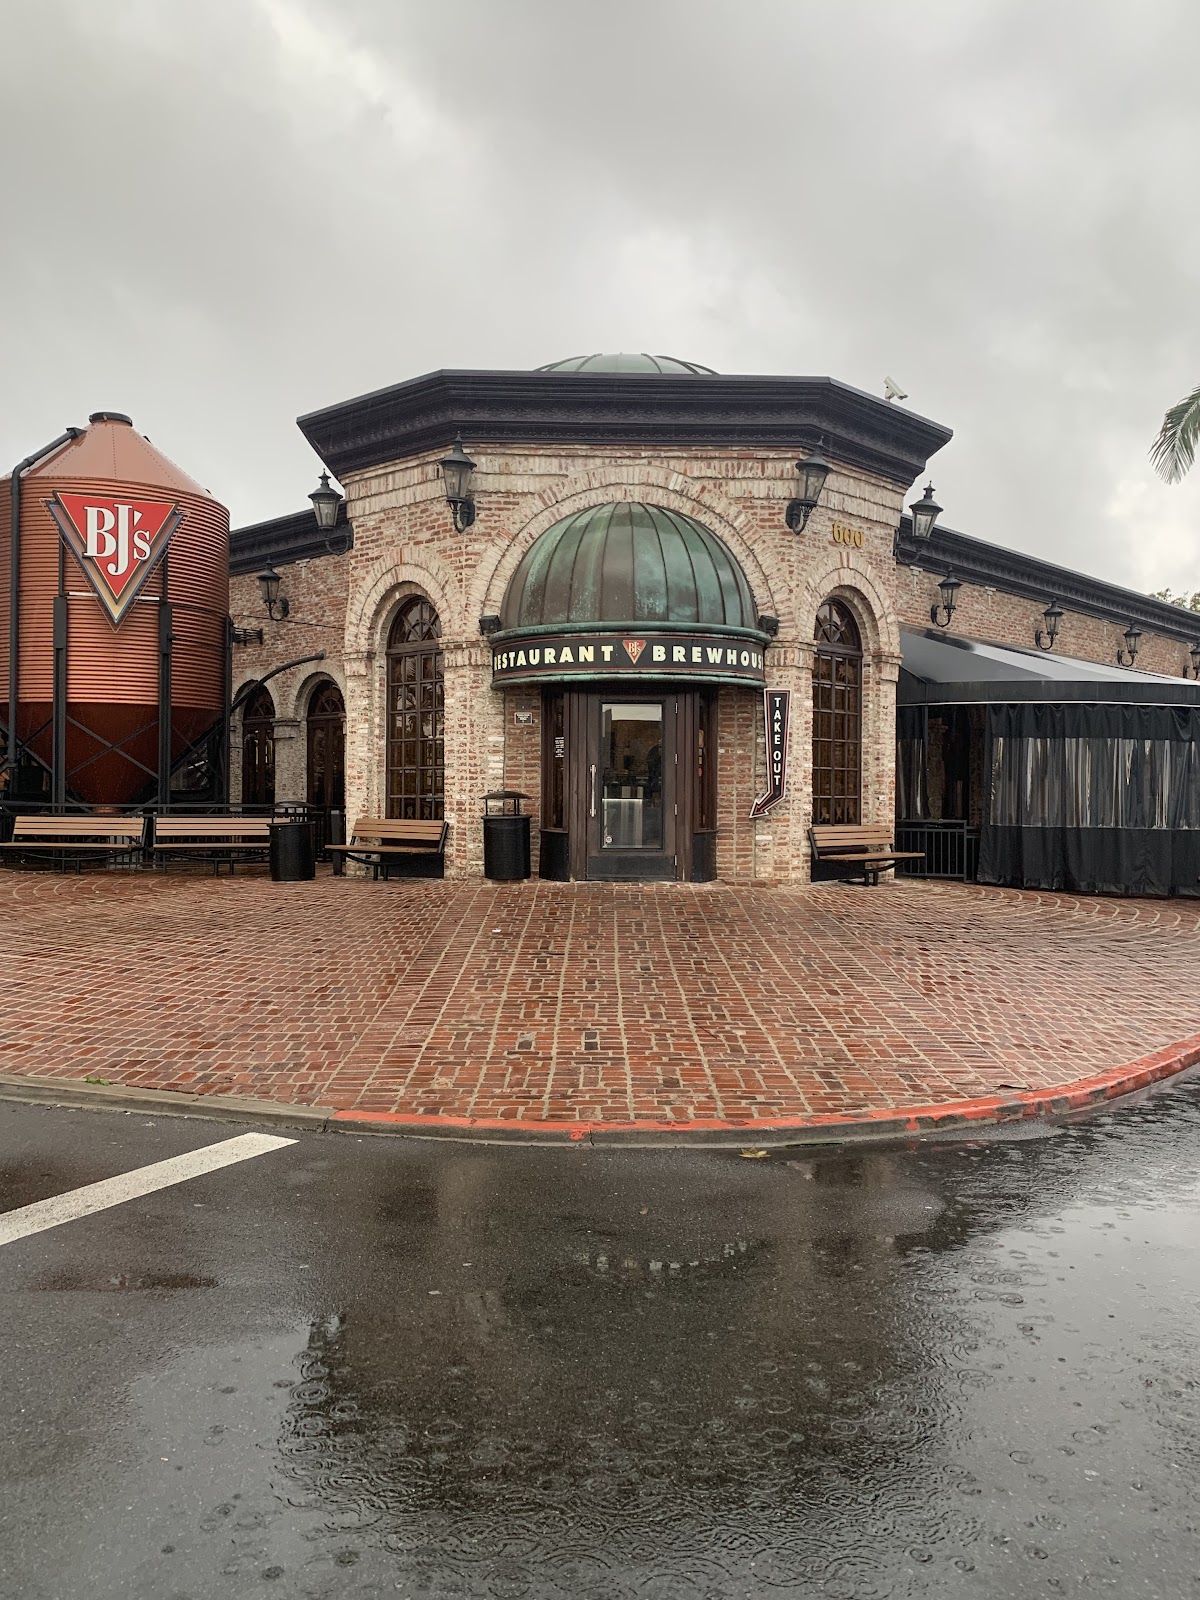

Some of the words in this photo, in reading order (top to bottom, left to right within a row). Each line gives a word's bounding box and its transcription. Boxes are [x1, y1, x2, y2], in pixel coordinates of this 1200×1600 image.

[83, 503, 151, 576] BJ's
[832, 519, 865, 548] 600
[773, 697, 782, 745] TAKE
[773, 750, 782, 786] OUT
